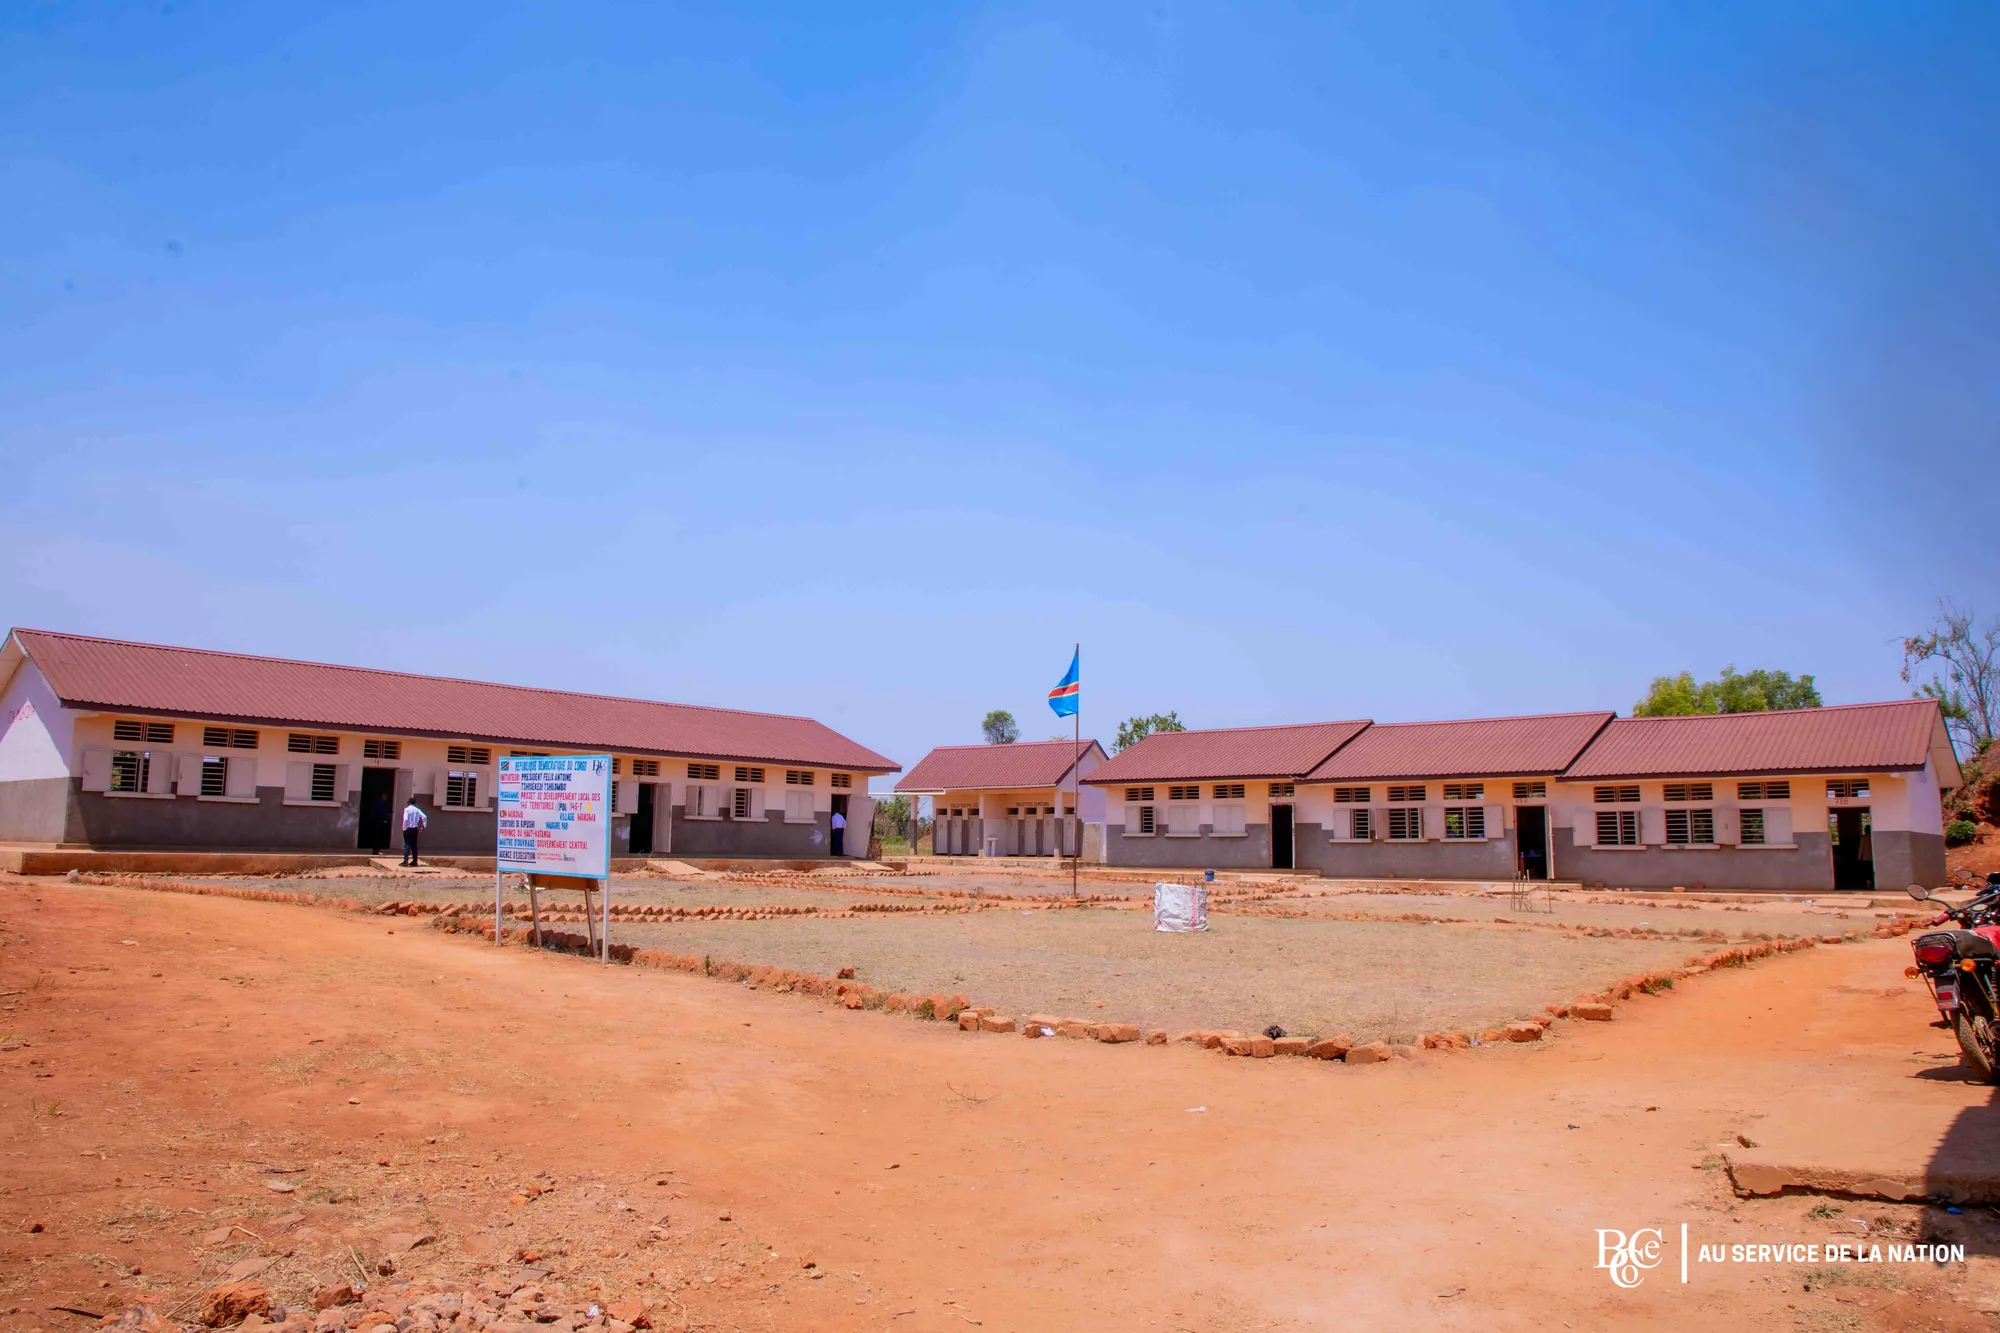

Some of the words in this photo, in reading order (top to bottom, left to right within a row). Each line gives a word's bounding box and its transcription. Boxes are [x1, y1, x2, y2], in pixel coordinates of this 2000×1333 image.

[521, 773, 543, 781] PRESIDENT
[555, 773, 572, 781] ANTOINE
[543, 793, 577, 801] DEVELOPPEMENT
[578, 793, 590, 801] LOCAL
[592, 793, 601, 801] DES
[529, 802, 554, 810] TERRITOIRES
[560, 813, 574, 821] VILLAGE
[536, 840, 567, 849] GOUVERNEMENT
[569, 841, 588, 849] CENTRAL
